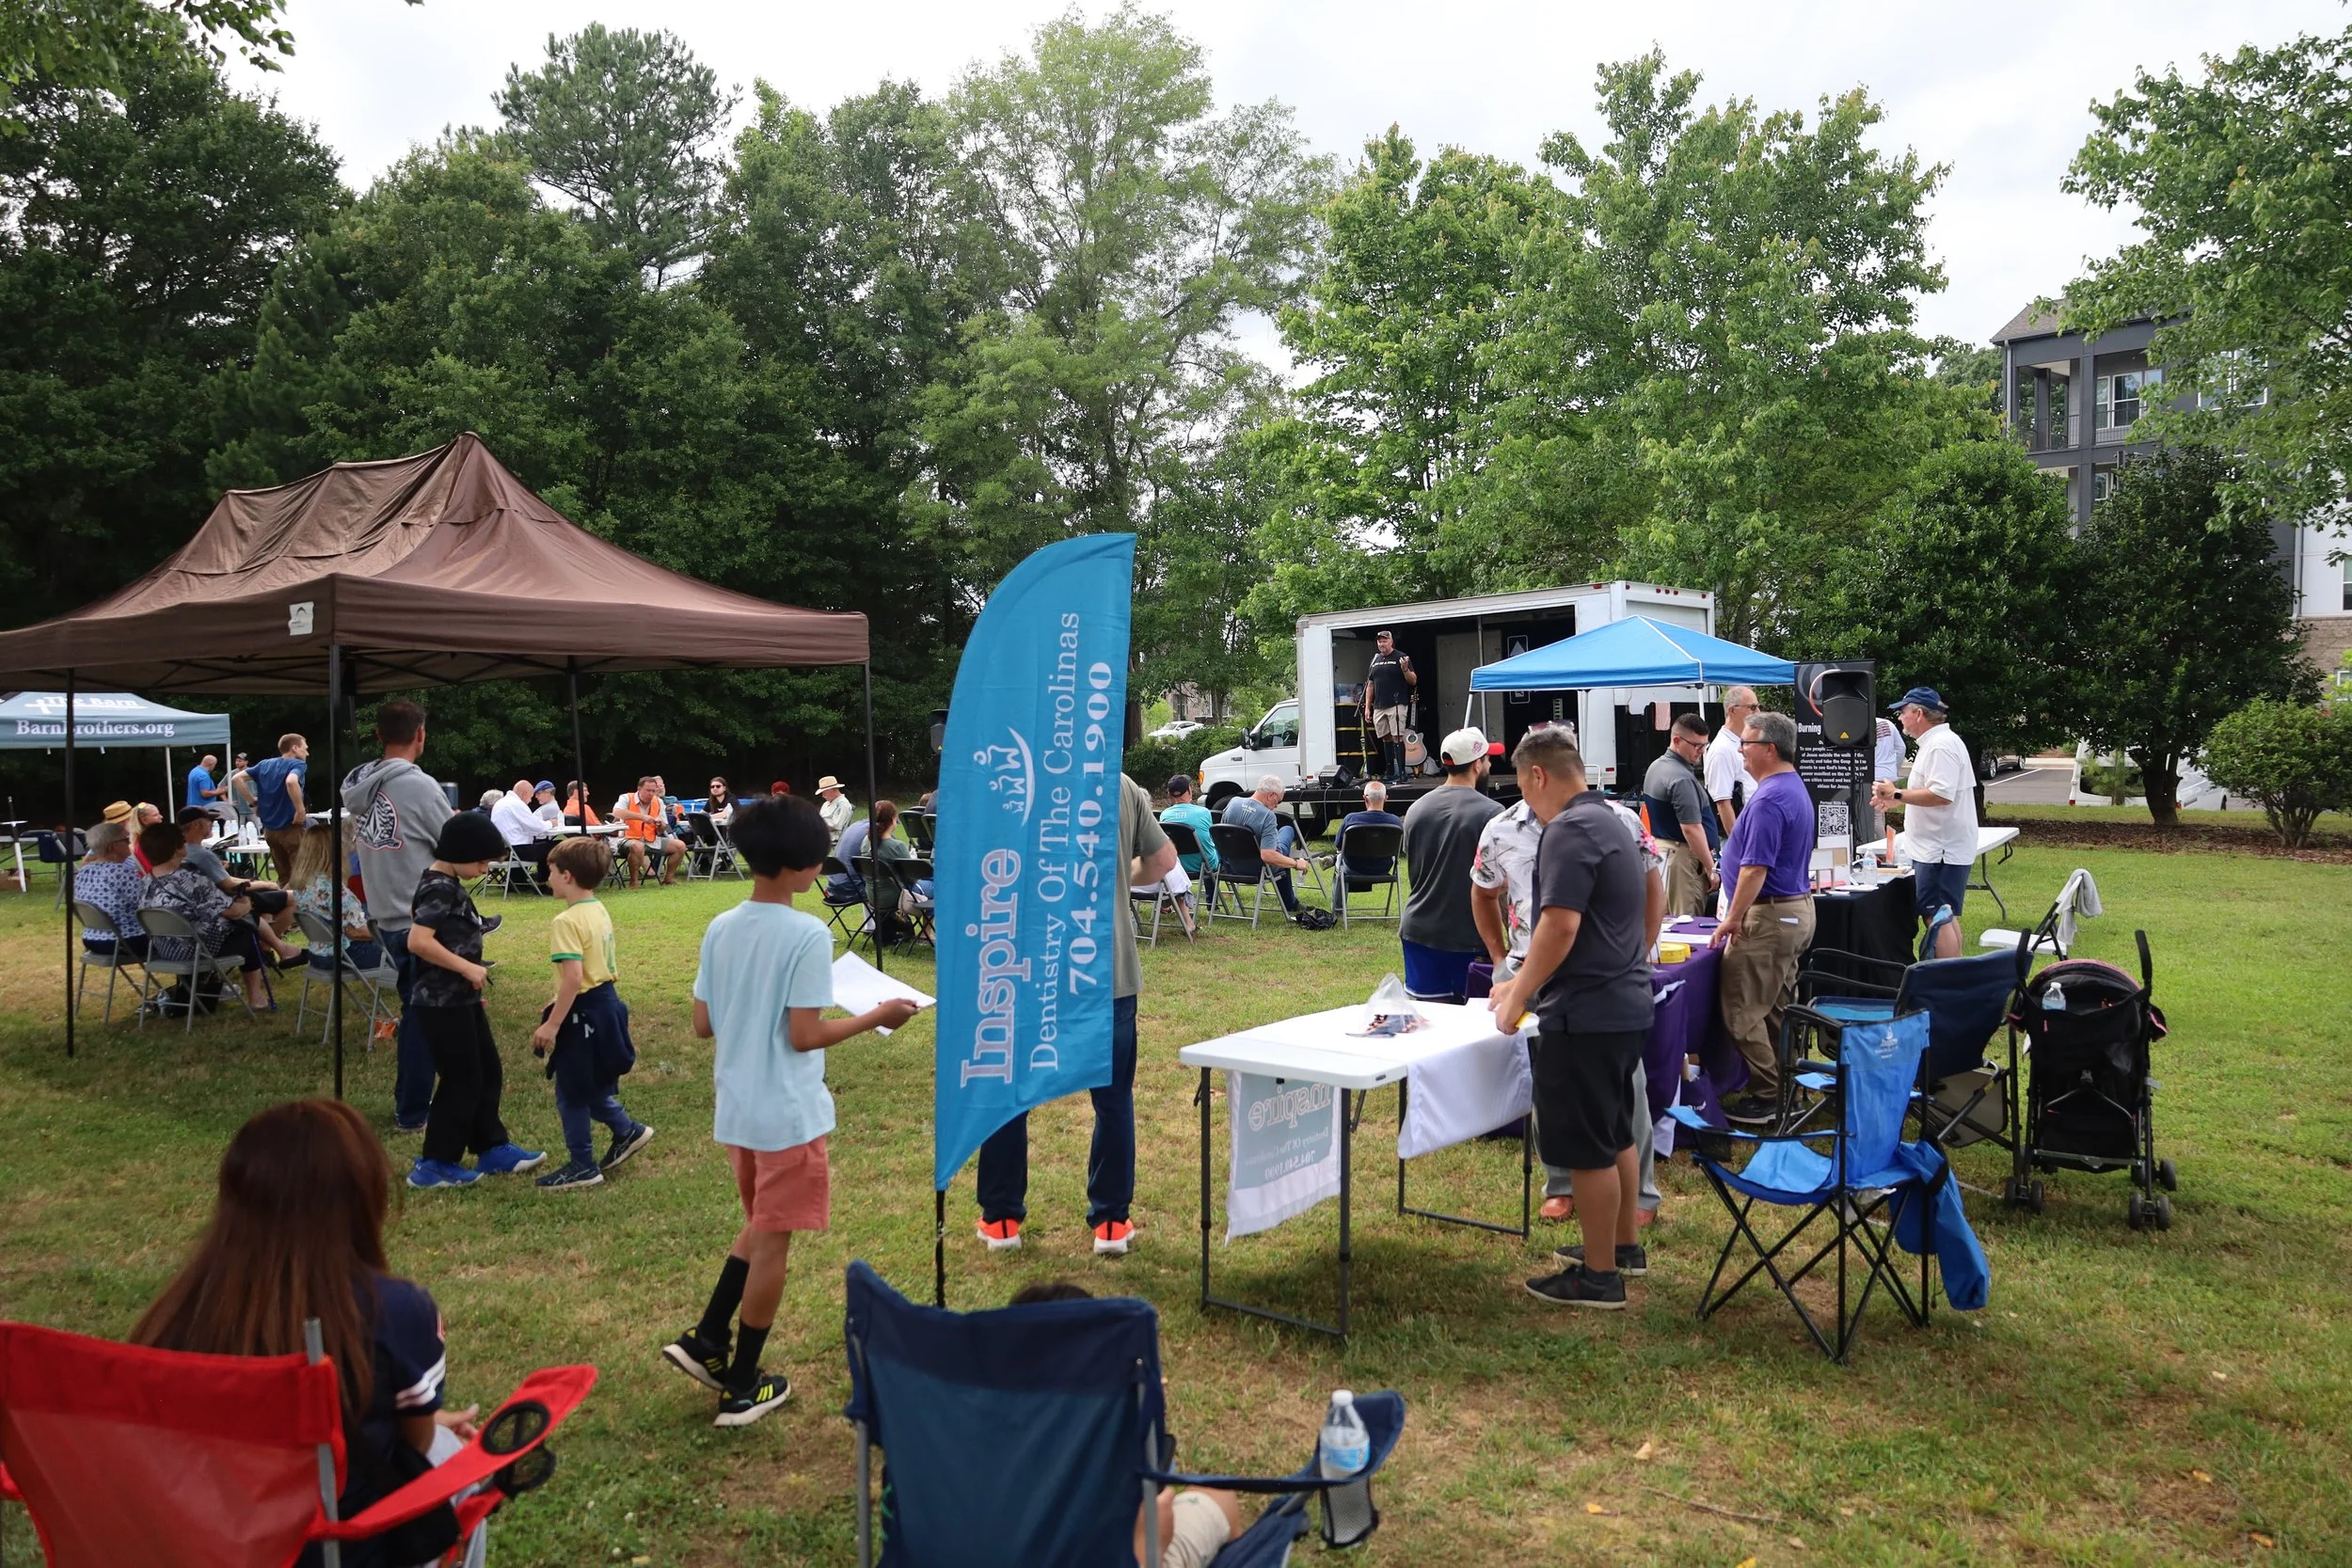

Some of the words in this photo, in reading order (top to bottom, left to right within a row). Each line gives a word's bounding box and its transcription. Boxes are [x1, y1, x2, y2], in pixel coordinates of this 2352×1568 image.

[90, 698, 139, 707] Barn
[1043, 612, 1080, 774] Carolinas
[1798, 722, 1821, 736] Burning
[1039, 786, 1072, 852] The
[1070, 662, 1112, 995] 704.540.1900
[1038, 859, 1067, 903] Of
[960, 848, 1031, 1088] Inspire
[1030, 913, 1067, 1072] Dentistry
